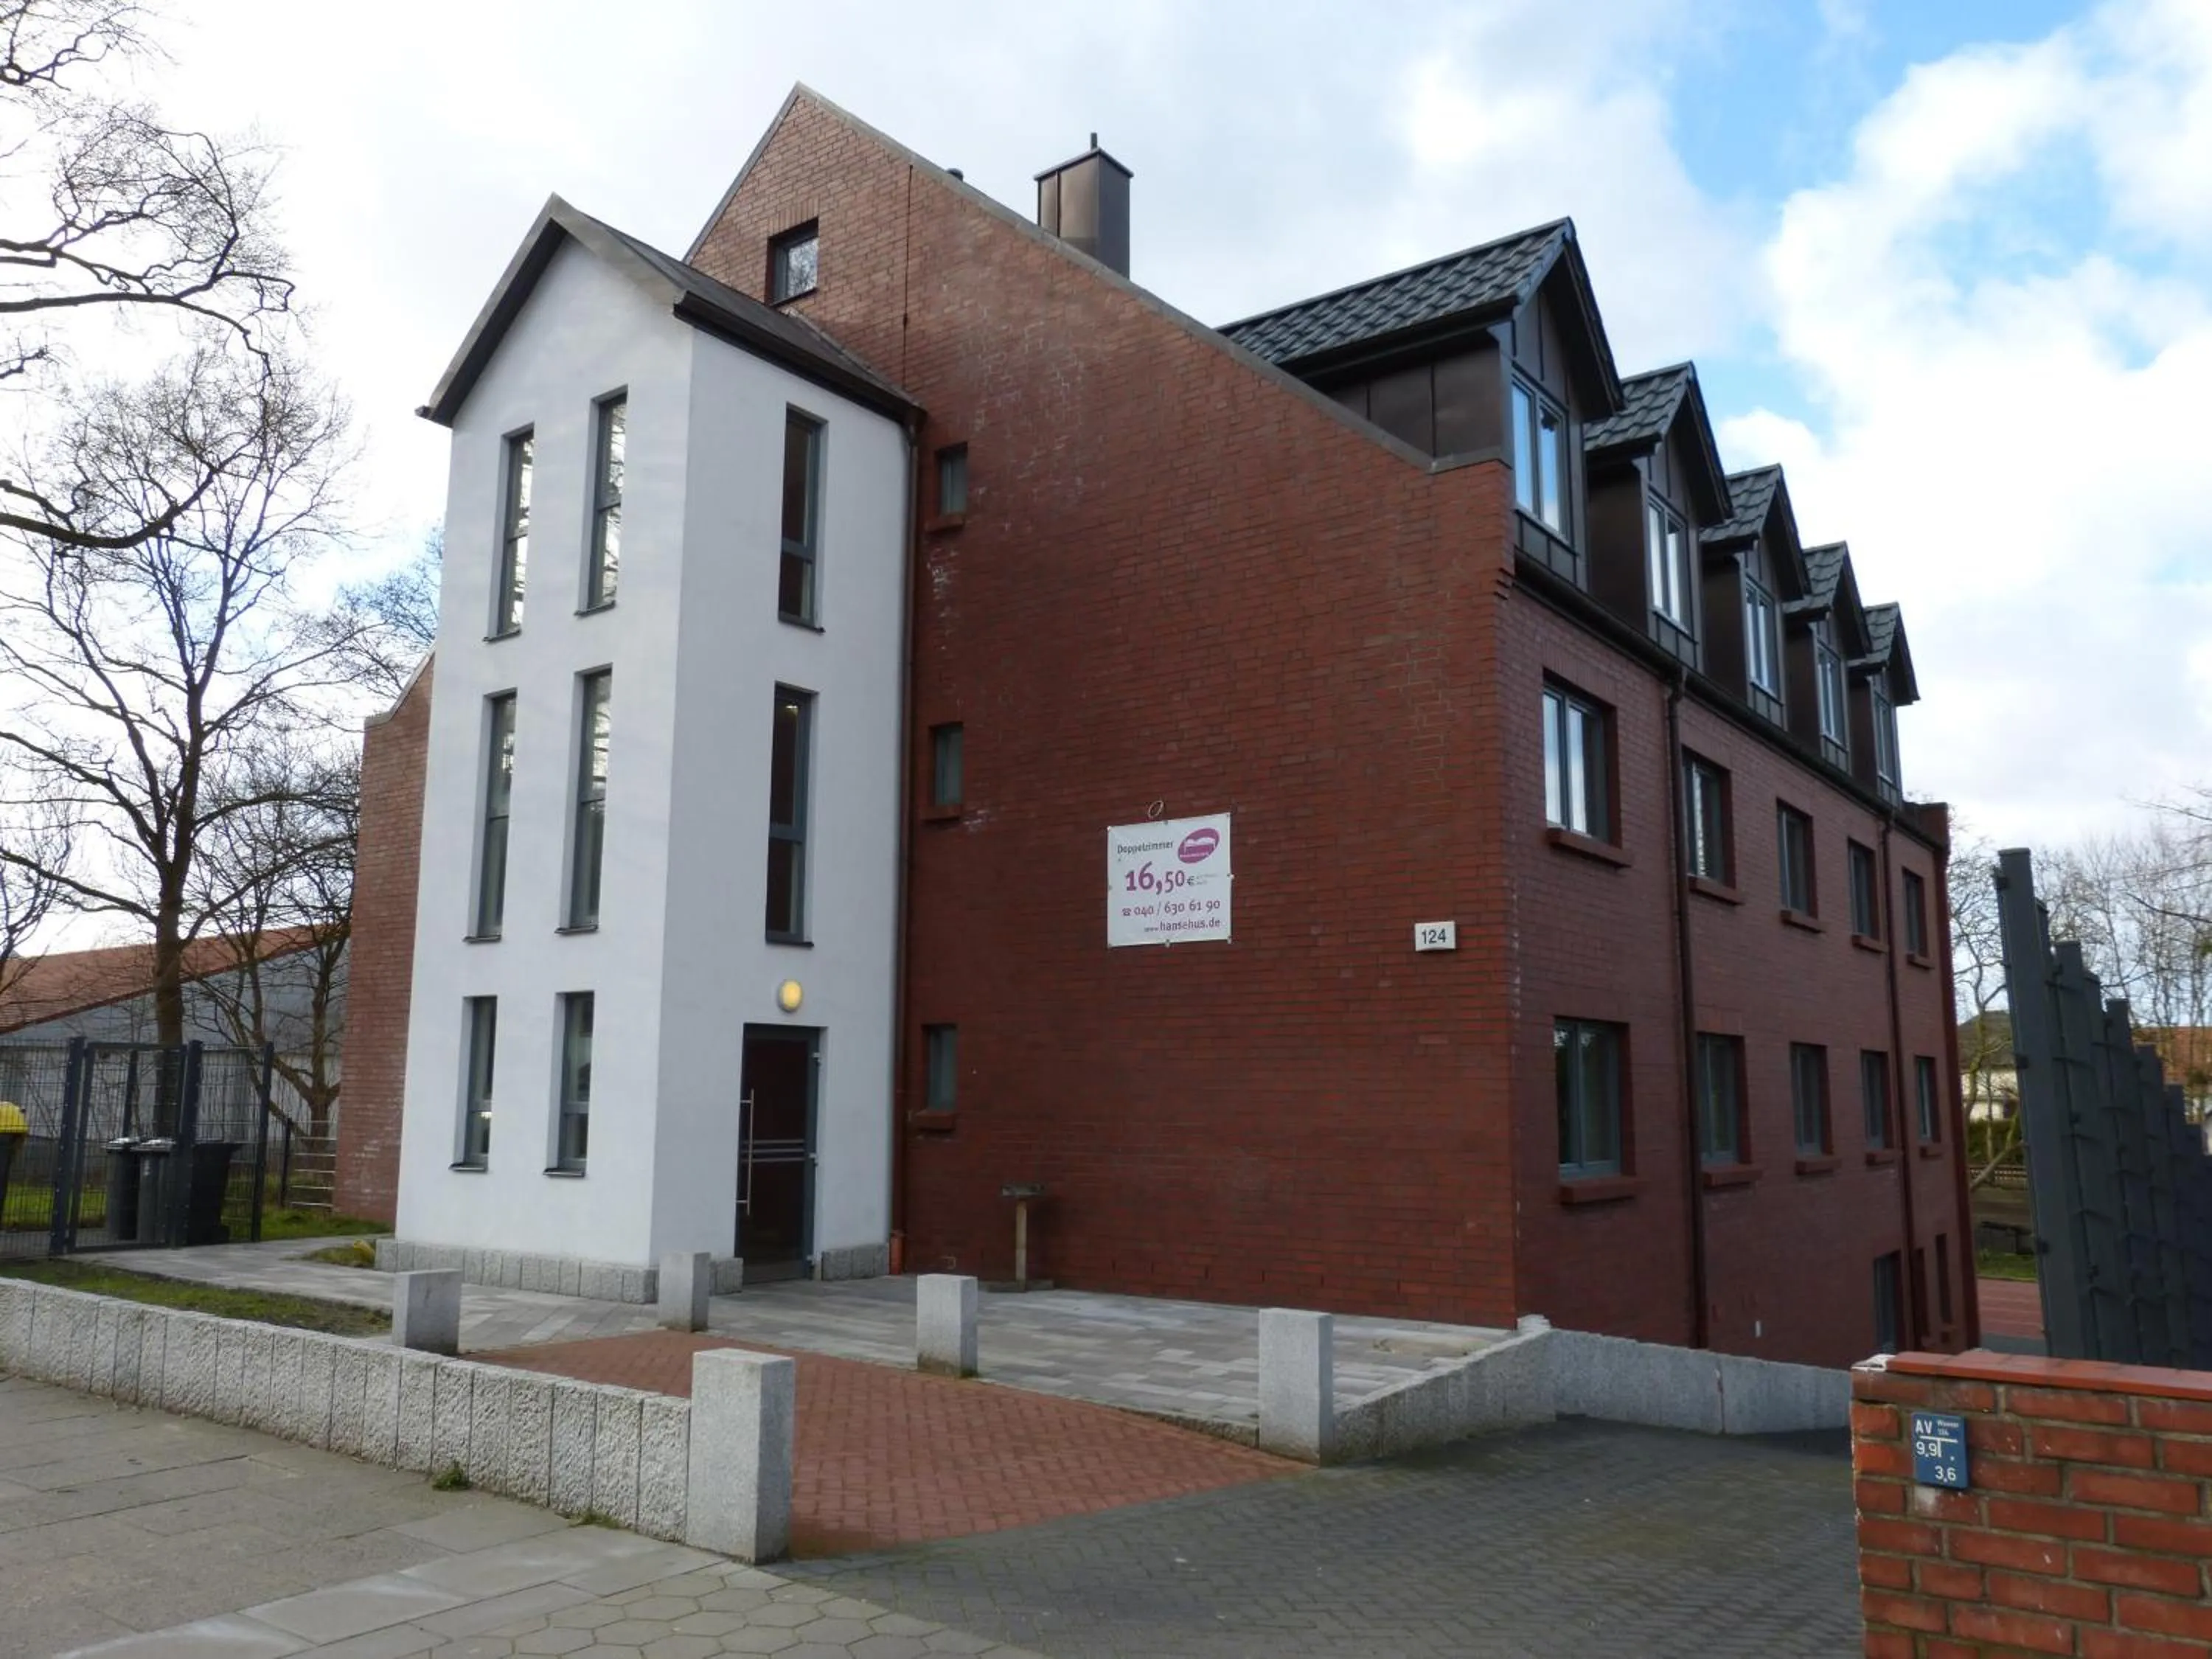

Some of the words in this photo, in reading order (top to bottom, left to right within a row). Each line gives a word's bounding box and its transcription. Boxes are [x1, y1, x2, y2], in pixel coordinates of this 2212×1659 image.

[1133, 905, 1154, 917] 040
[1164, 900, 1185, 915] 630
[1189, 899, 1202, 912] 61
[1206, 900, 1220, 912] 90
[1422, 928, 1446, 945] 124
[1915, 1419, 1933, 1434] AV
